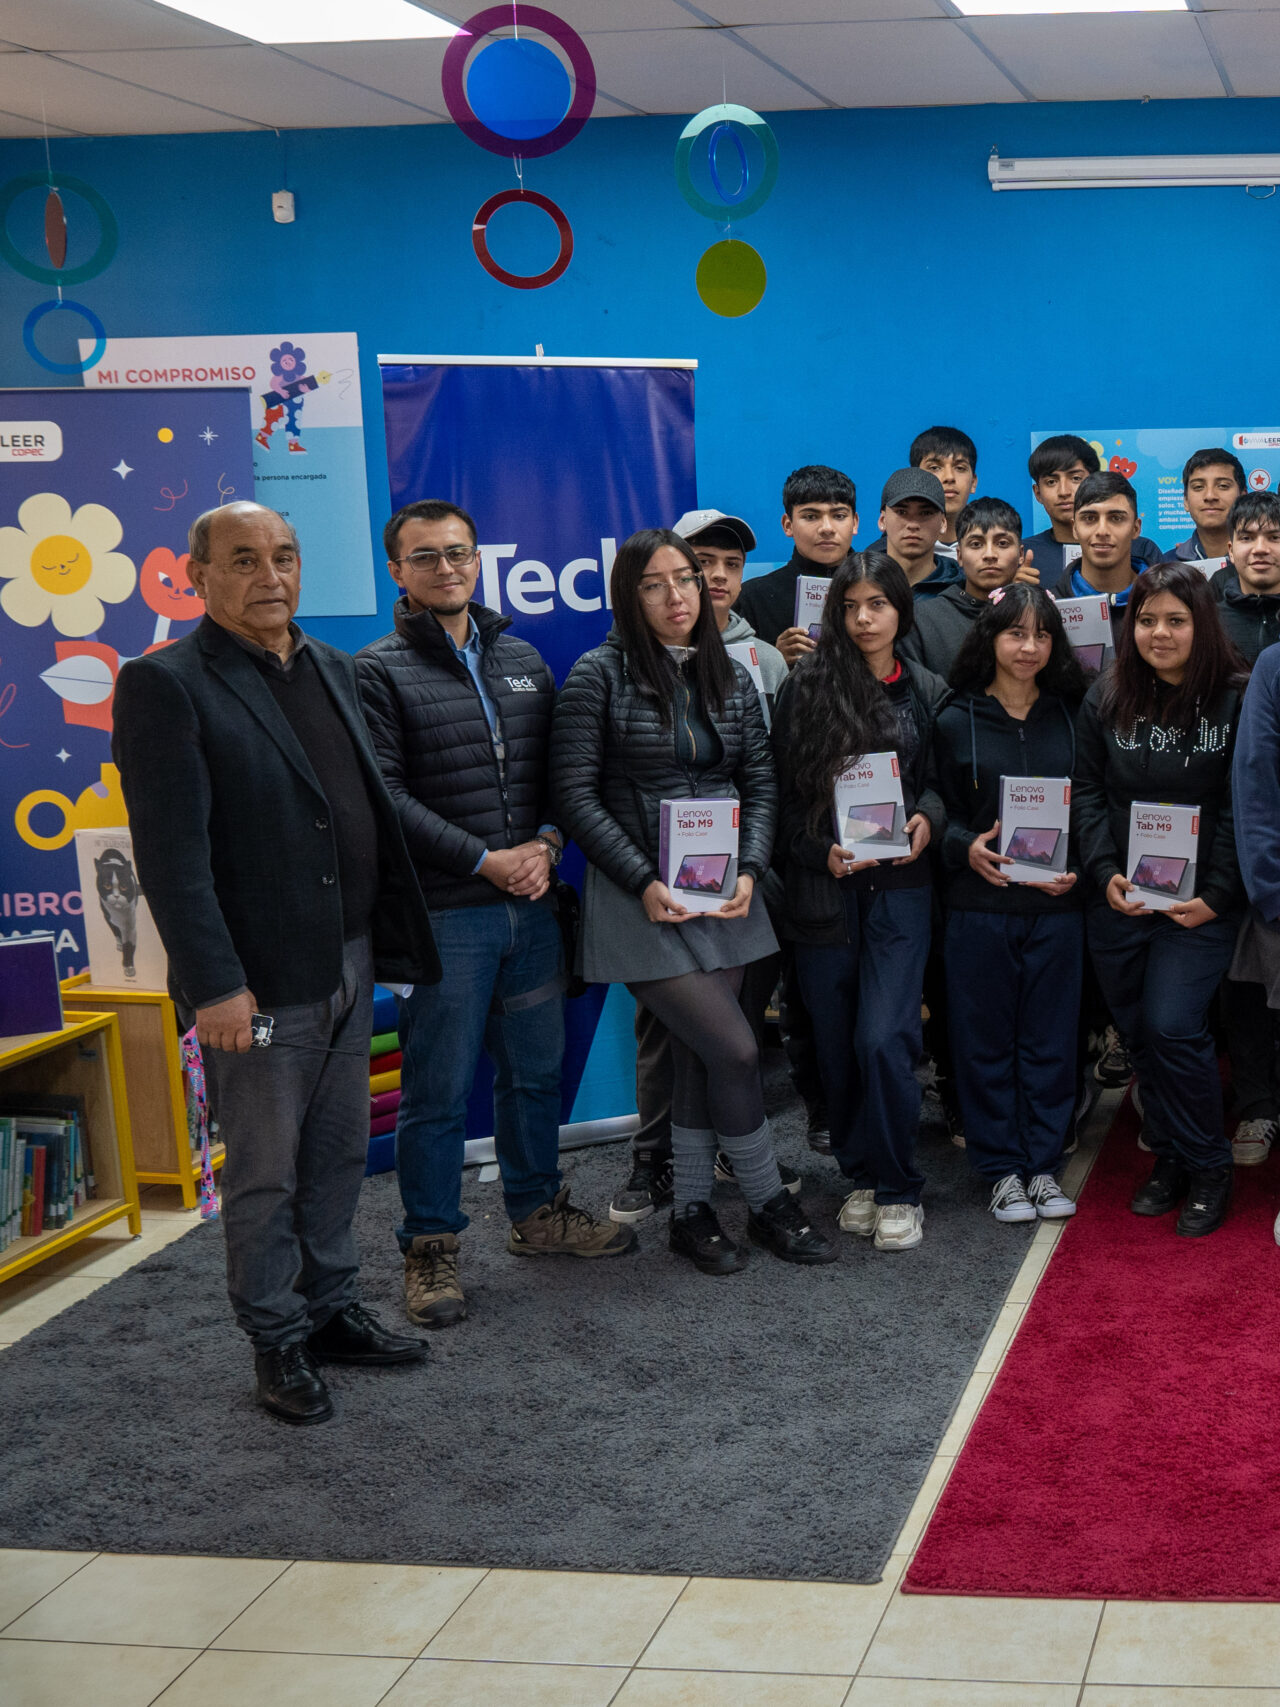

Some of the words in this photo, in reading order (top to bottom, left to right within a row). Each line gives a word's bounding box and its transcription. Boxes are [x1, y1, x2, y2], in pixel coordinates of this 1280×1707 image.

[98, 369, 119, 384] MI
[126, 366, 256, 383] COMPROMISO
[806, 582, 828, 591] Leno
[805, 592, 822, 600] Tab
[1069, 614, 1083, 623] M9
[504, 676, 535, 688] Teck
[858, 771, 874, 779] M9
[1010, 784, 1044, 793] Lenovo
[1010, 794, 1027, 802] Tab
[1029, 794, 1045, 803] M9
[677, 810, 713, 818] Lenovo
[1136, 811, 1172, 821] Lenovo
[677, 820, 695, 828] Tab
[698, 819, 713, 828] M9
[1136, 821, 1153, 830] Tab
[1157, 823, 1172, 831] M9
[0, 891, 84, 917] IBRO
